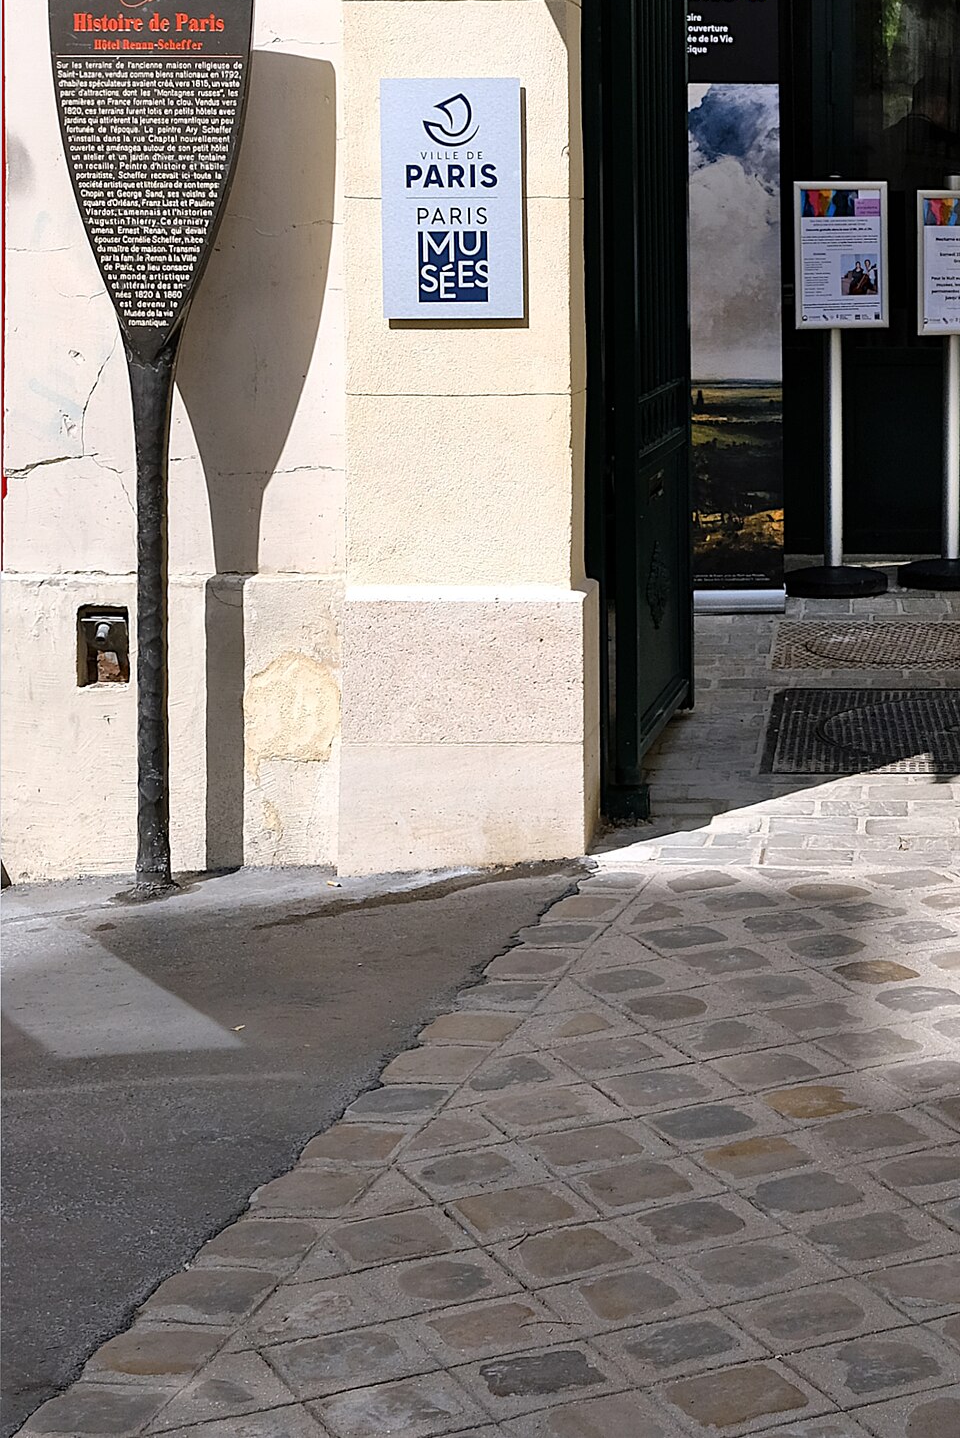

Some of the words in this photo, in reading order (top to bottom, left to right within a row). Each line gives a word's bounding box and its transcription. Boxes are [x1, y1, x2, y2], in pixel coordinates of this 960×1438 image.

[73, 12, 144, 32] Histoire
[149, 12, 171, 32] de
[175, 12, 225, 32] Paris
[94, 39, 120, 51] Hôtel
[195, 61, 230, 71] religieuse
[148, 135, 177, 144] Chaptal
[193, 144, 209, 153] petit
[420, 151, 459, 160] VILLE
[467, 151, 484, 160] DE
[406, 164, 498, 189] PARIS
[81, 190, 104, 199] Chopin
[117, 190, 142, 199] George
[145, 190, 165, 199] Sand,
[417, 207, 488, 225] PARIS
[149, 272, 190, 282] artistique
